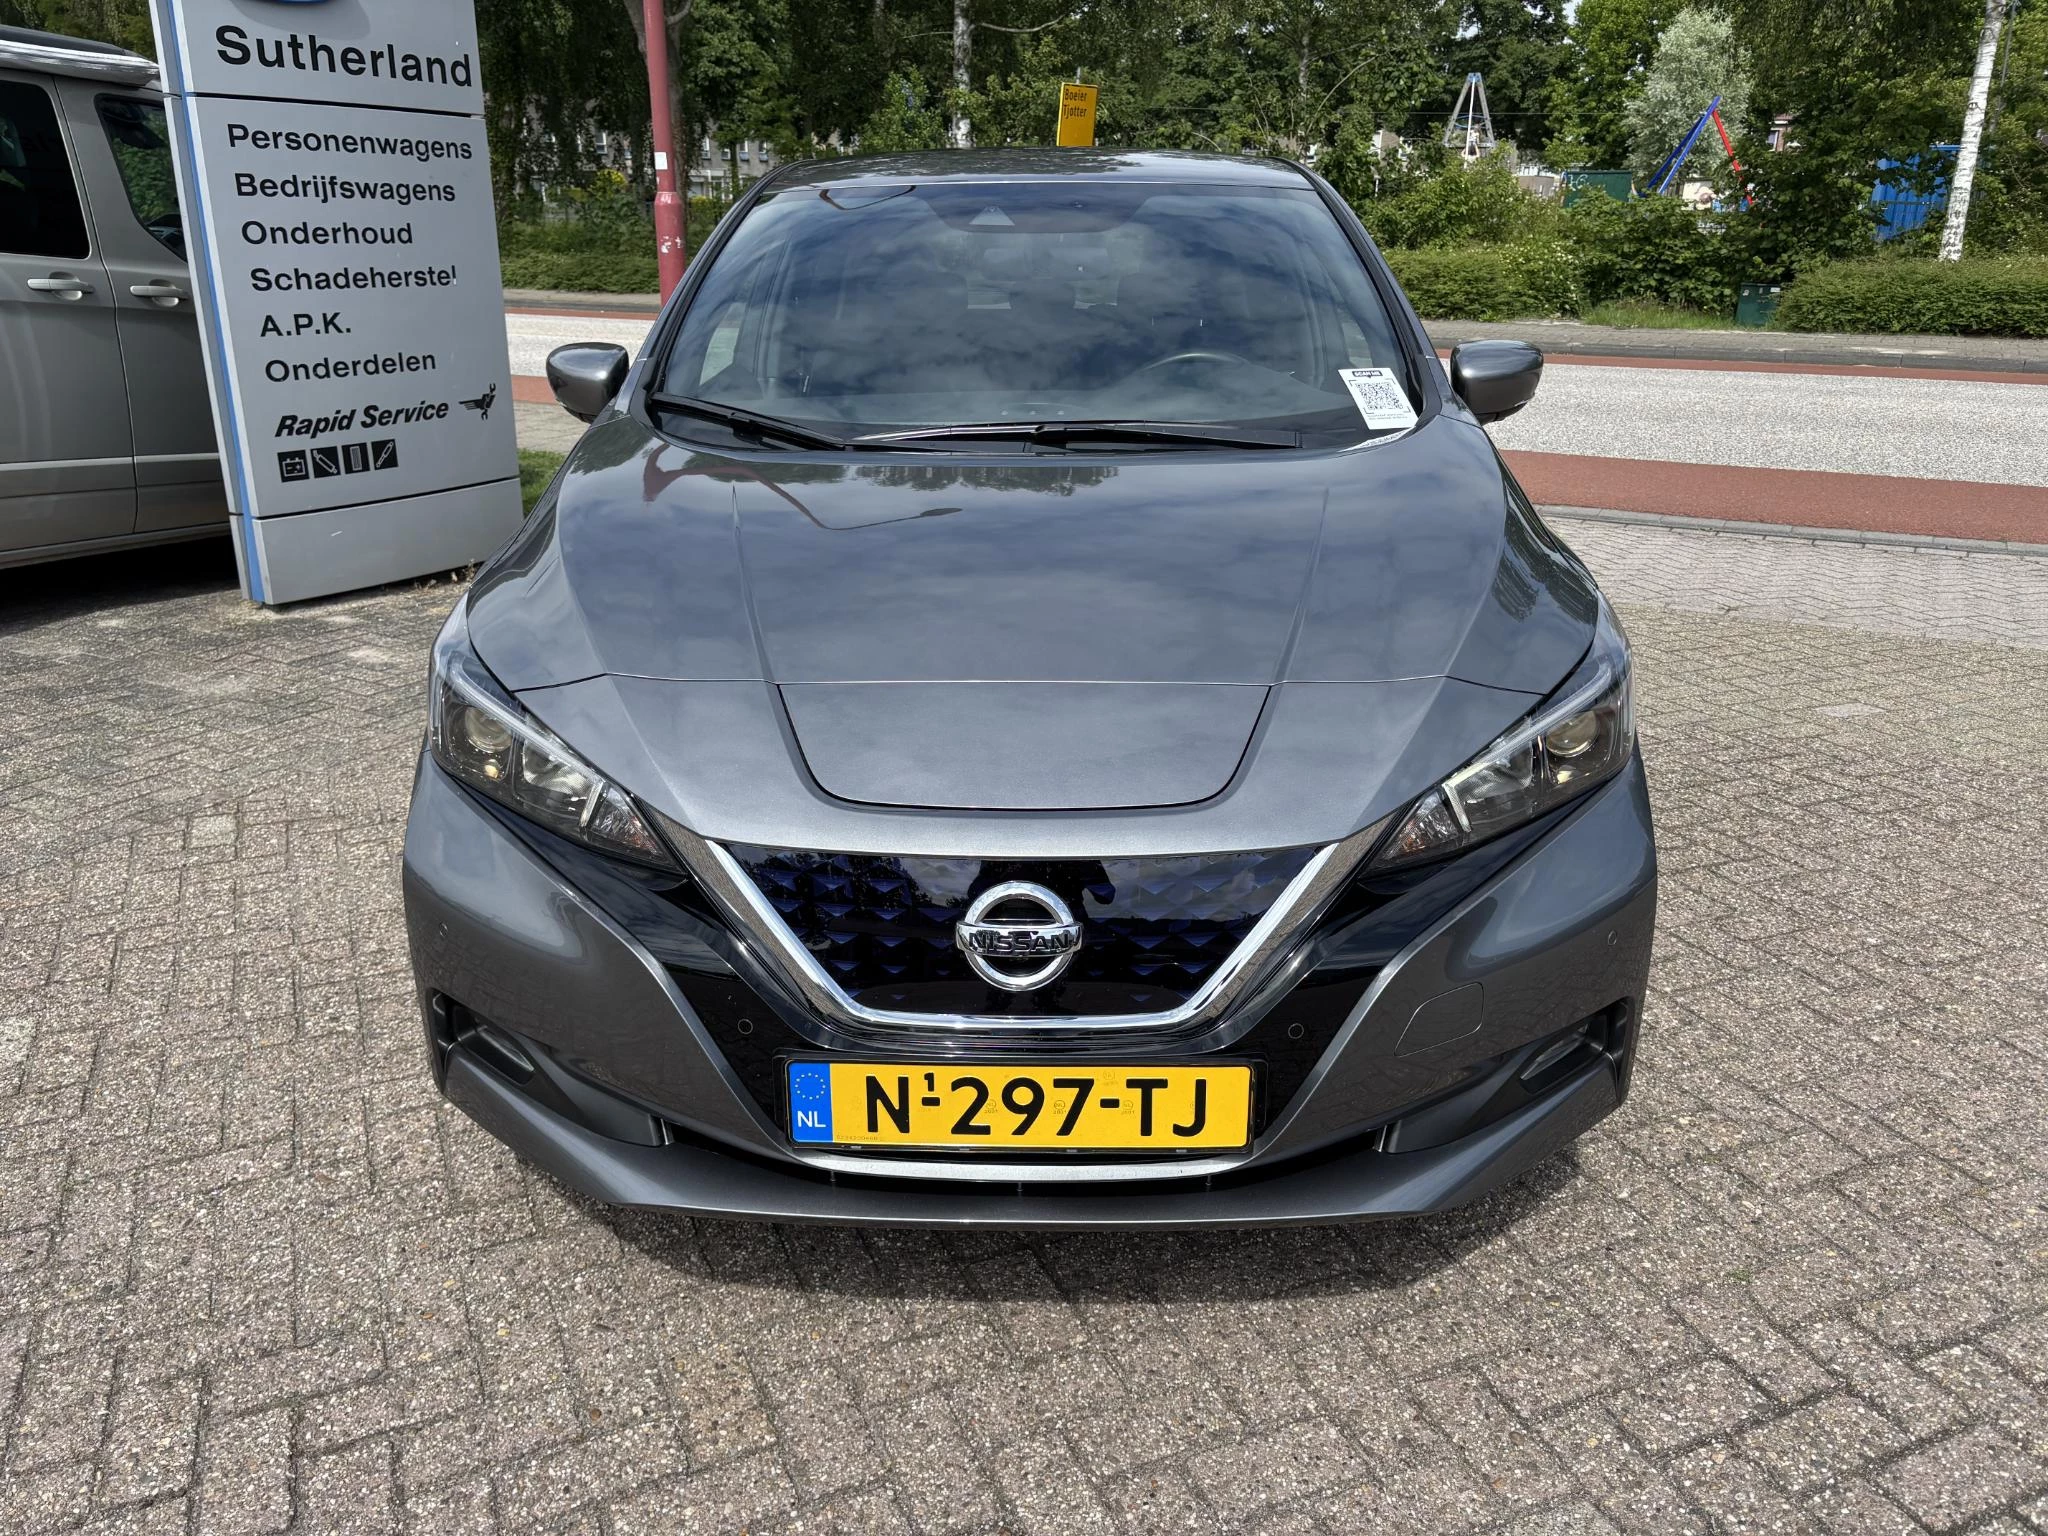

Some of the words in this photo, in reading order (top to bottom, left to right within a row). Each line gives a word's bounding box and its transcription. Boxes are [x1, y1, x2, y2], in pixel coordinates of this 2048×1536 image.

[215, 25, 472, 87] Sutherland
[1064, 88, 1087, 102] Boeier
[1063, 104, 1087, 119] Tjotter
[227, 123, 473, 163] Personenwagens
[234, 172, 456, 206] Bedrijfswagens
[241, 220, 414, 245] Onderhoud
[250, 264, 457, 292] Schadeherstel
[260, 312, 352, 338] A.P.K.
[265, 351, 436, 383] Onderdelen
[274, 408, 357, 440] Rapid
[360, 400, 450, 430] Service
[968, 929, 1070, 953] NISSAN
[796, 1110, 827, 1129] NL
